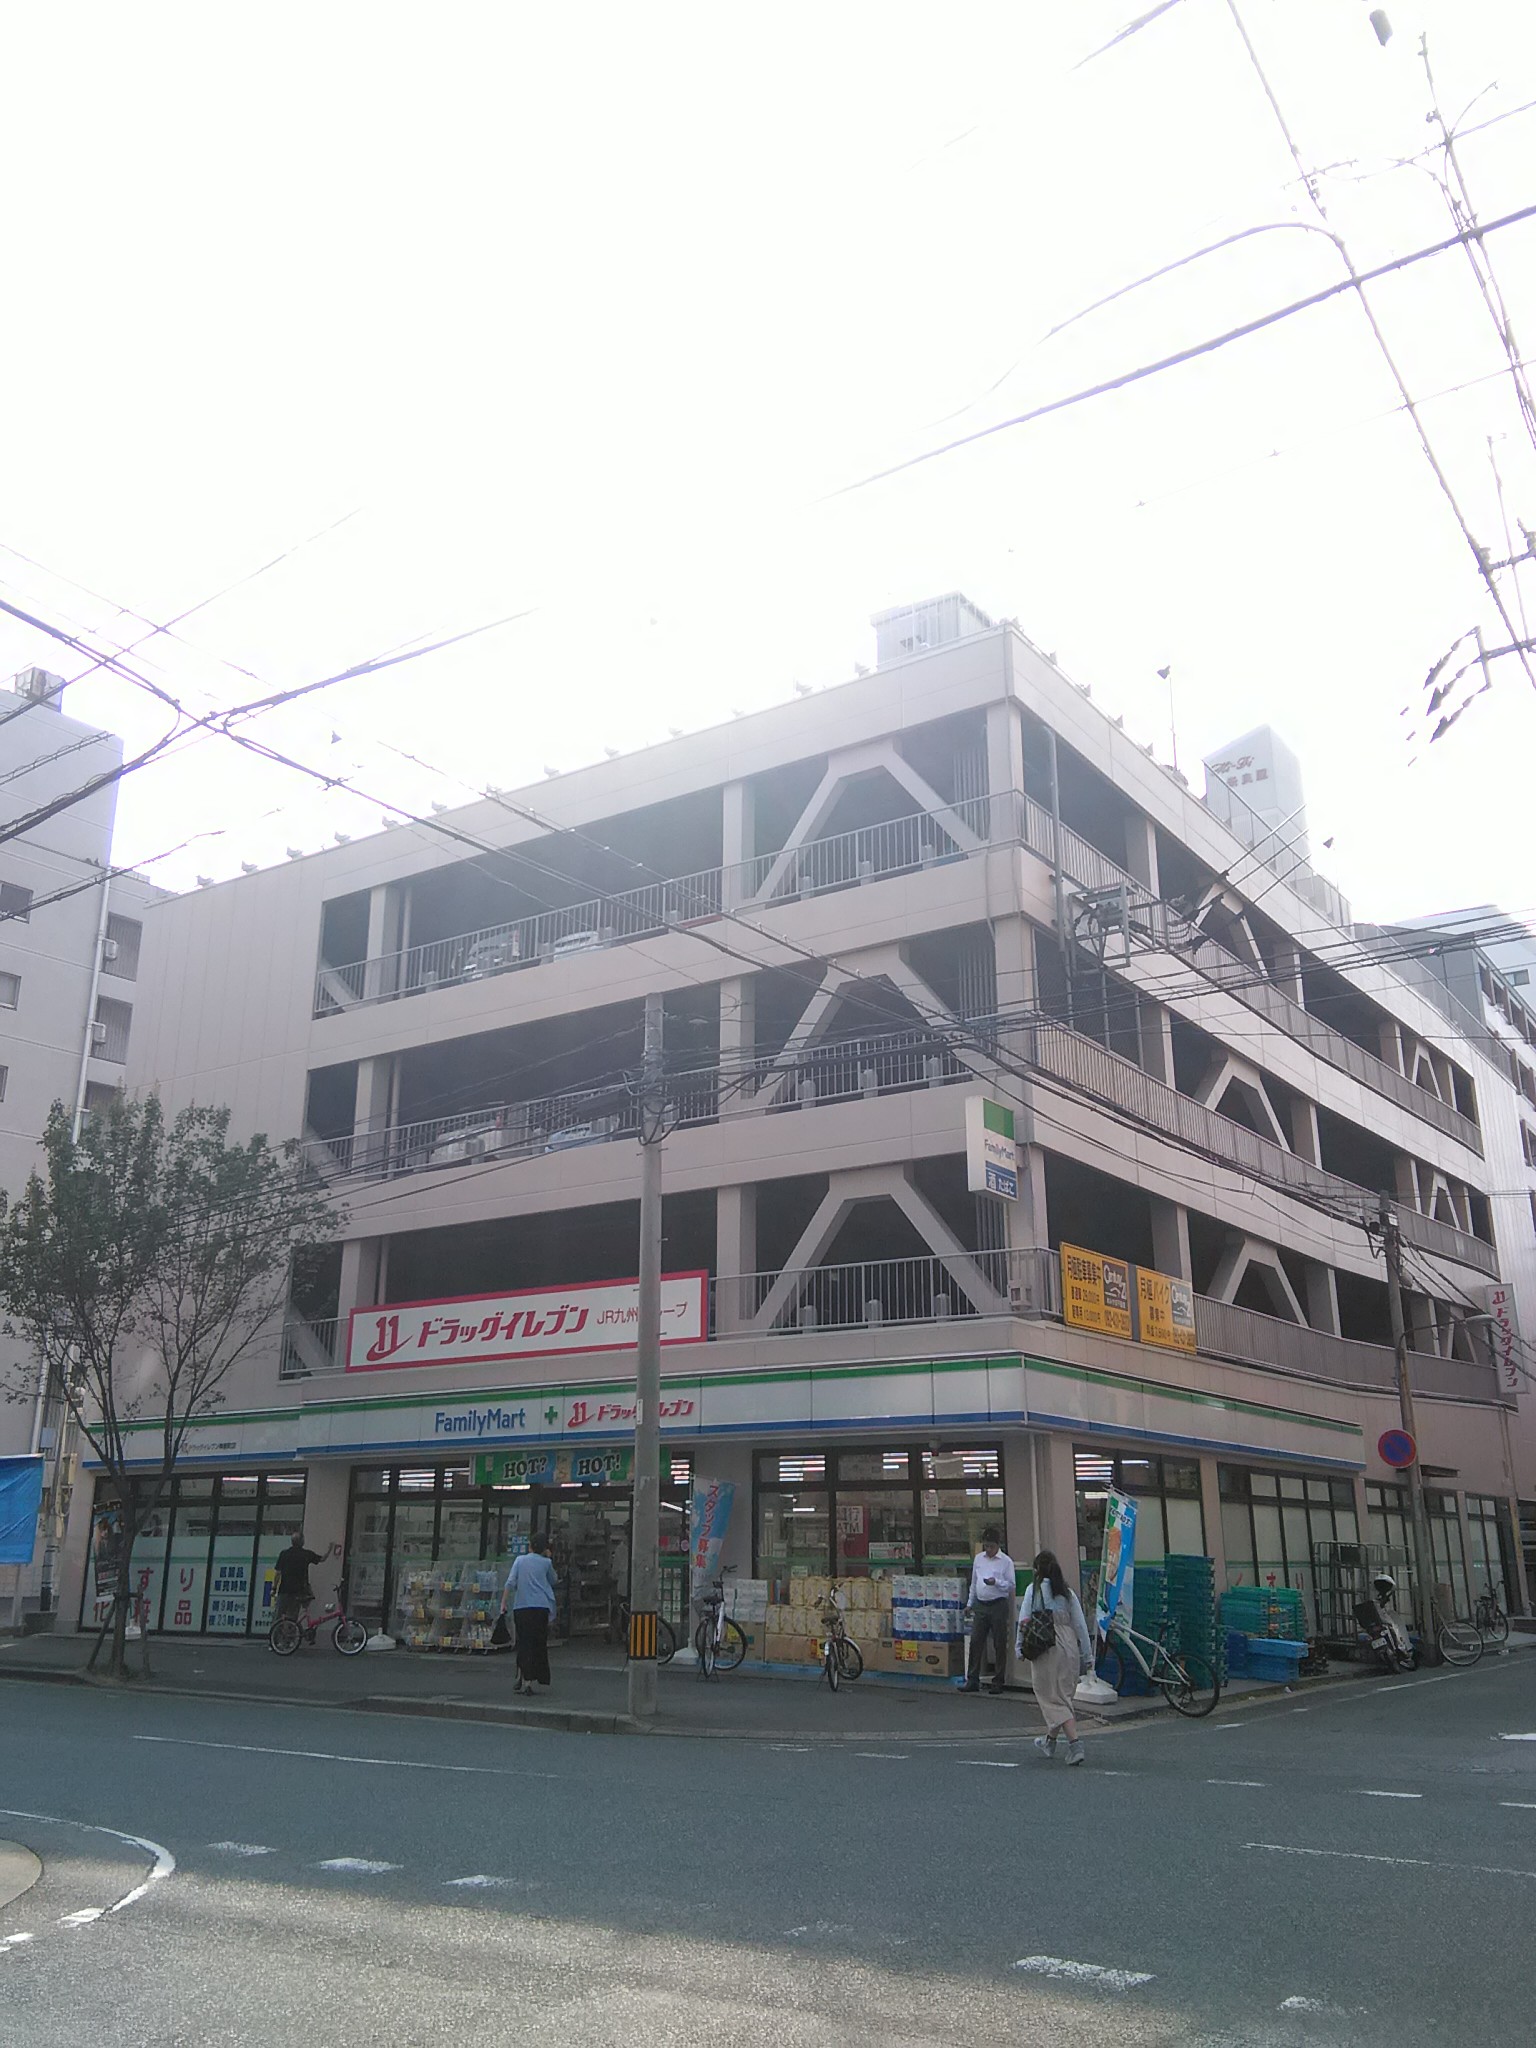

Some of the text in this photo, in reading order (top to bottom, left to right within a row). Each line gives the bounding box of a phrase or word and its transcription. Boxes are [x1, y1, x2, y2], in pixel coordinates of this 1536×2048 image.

[984, 1139, 1015, 1160] FamilyMart
[417, 1304, 589, 1348] ドラッグイレブン
[597, 1302, 688, 1325] JR九州ープ
[435, 1408, 526, 1436] FamilyMart
[597, 1400, 695, 1422] ドラッレブン
[503, 1454, 622, 1478] HOT? HOT!
